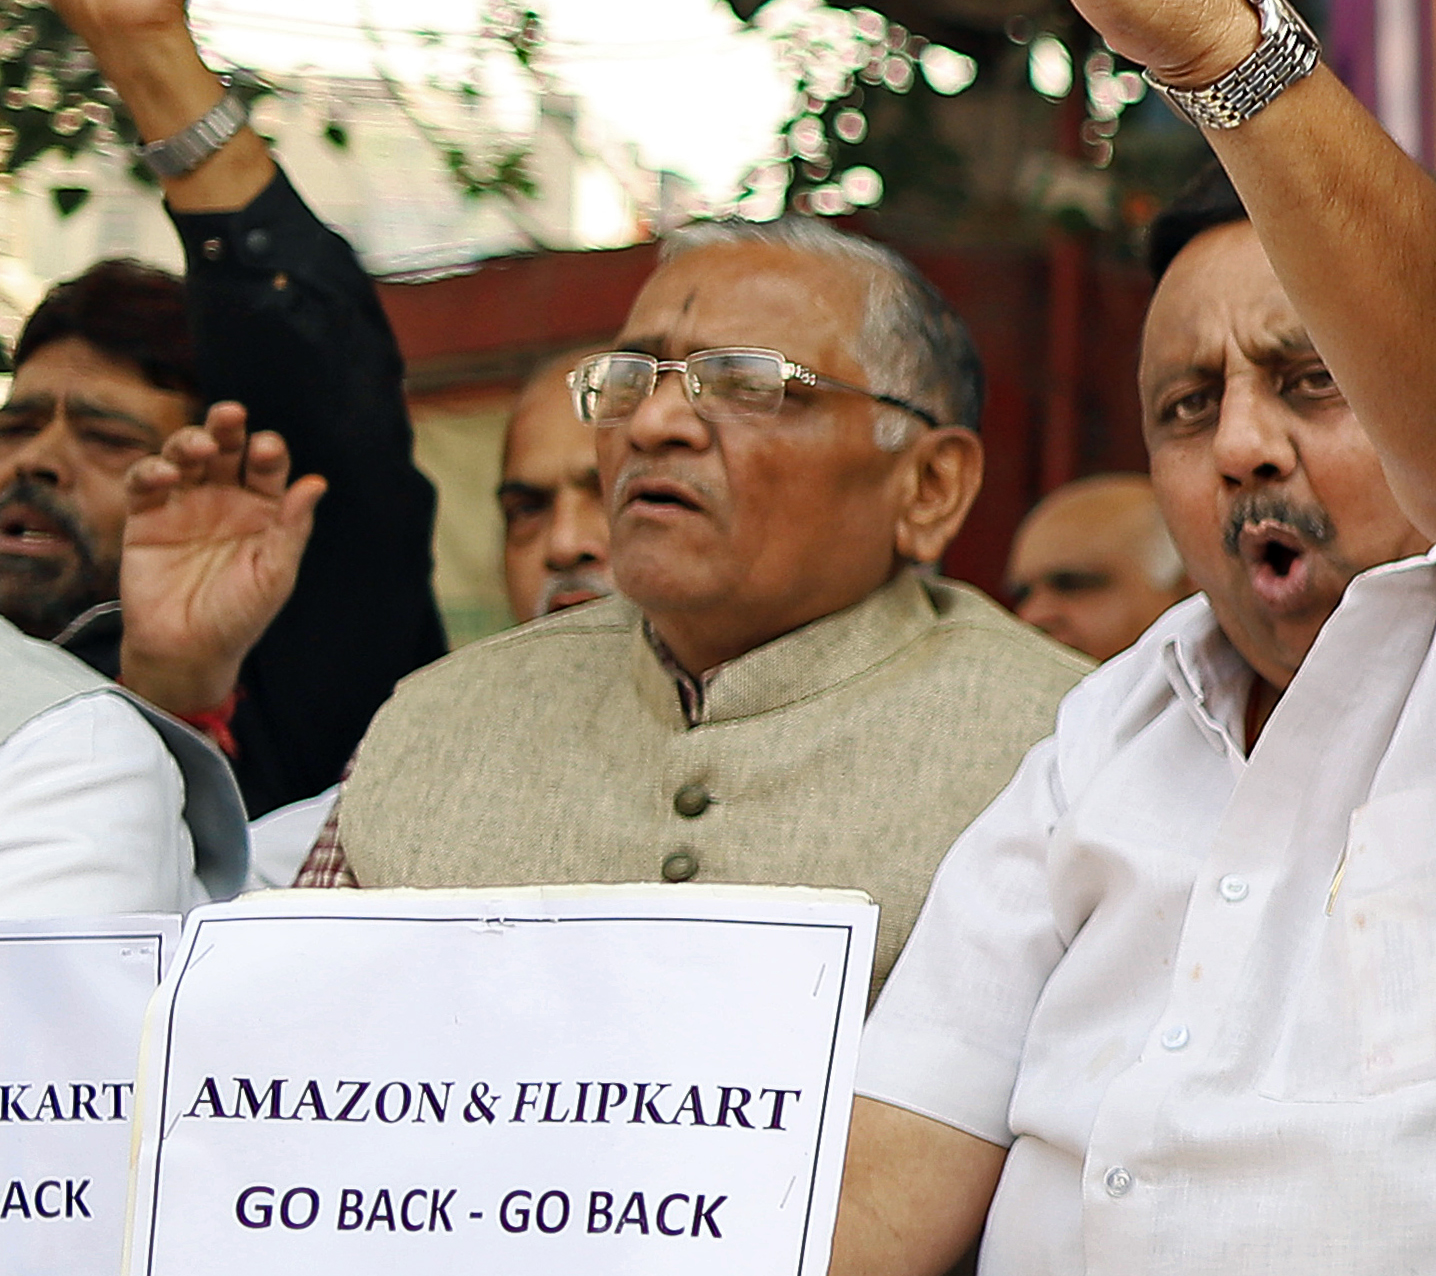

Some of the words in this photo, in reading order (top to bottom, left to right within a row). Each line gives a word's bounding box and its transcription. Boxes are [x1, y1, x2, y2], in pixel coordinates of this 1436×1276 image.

[0, 1082, 134, 1121] KART
[184, 1076, 452, 1124] AMAZON
[462, 1082, 501, 1124] &
[508, 1081, 802, 1132] FLIPKART
[0, 1178, 92, 1219] ACK
[236, 1185, 320, 1230] GO
[336, 1188, 457, 1233] BACK
[499, 1188, 570, 1234] GO
[586, 1190, 728, 1239] BACK
